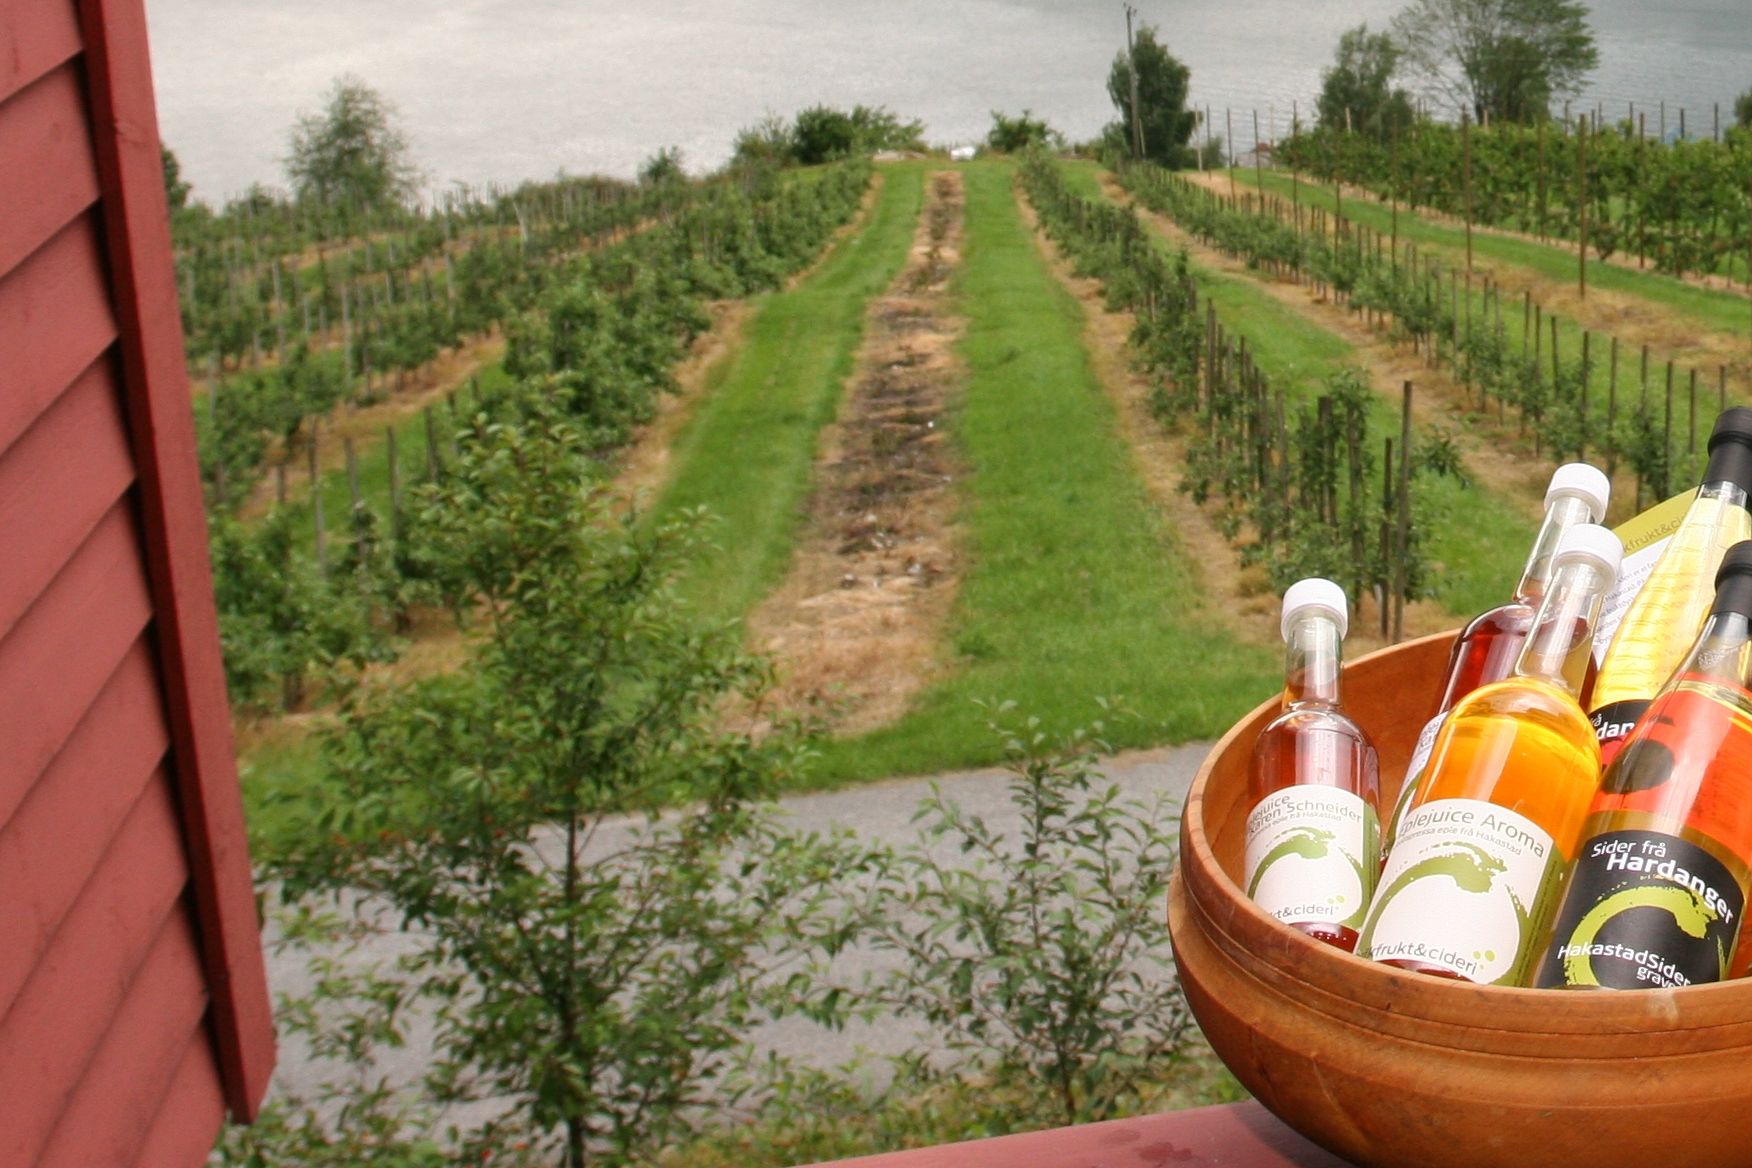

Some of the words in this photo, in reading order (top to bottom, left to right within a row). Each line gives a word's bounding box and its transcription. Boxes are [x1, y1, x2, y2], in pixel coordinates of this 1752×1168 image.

[1286, 799, 1362, 823] Schneider
[1480, 814, 1544, 859] Aroma
[1591, 840, 1637, 858] Sider
[1641, 840, 1667, 858] frå
[1606, 852, 1734, 924] Hardanger
[1557, 941, 1692, 987] HakastadSider
